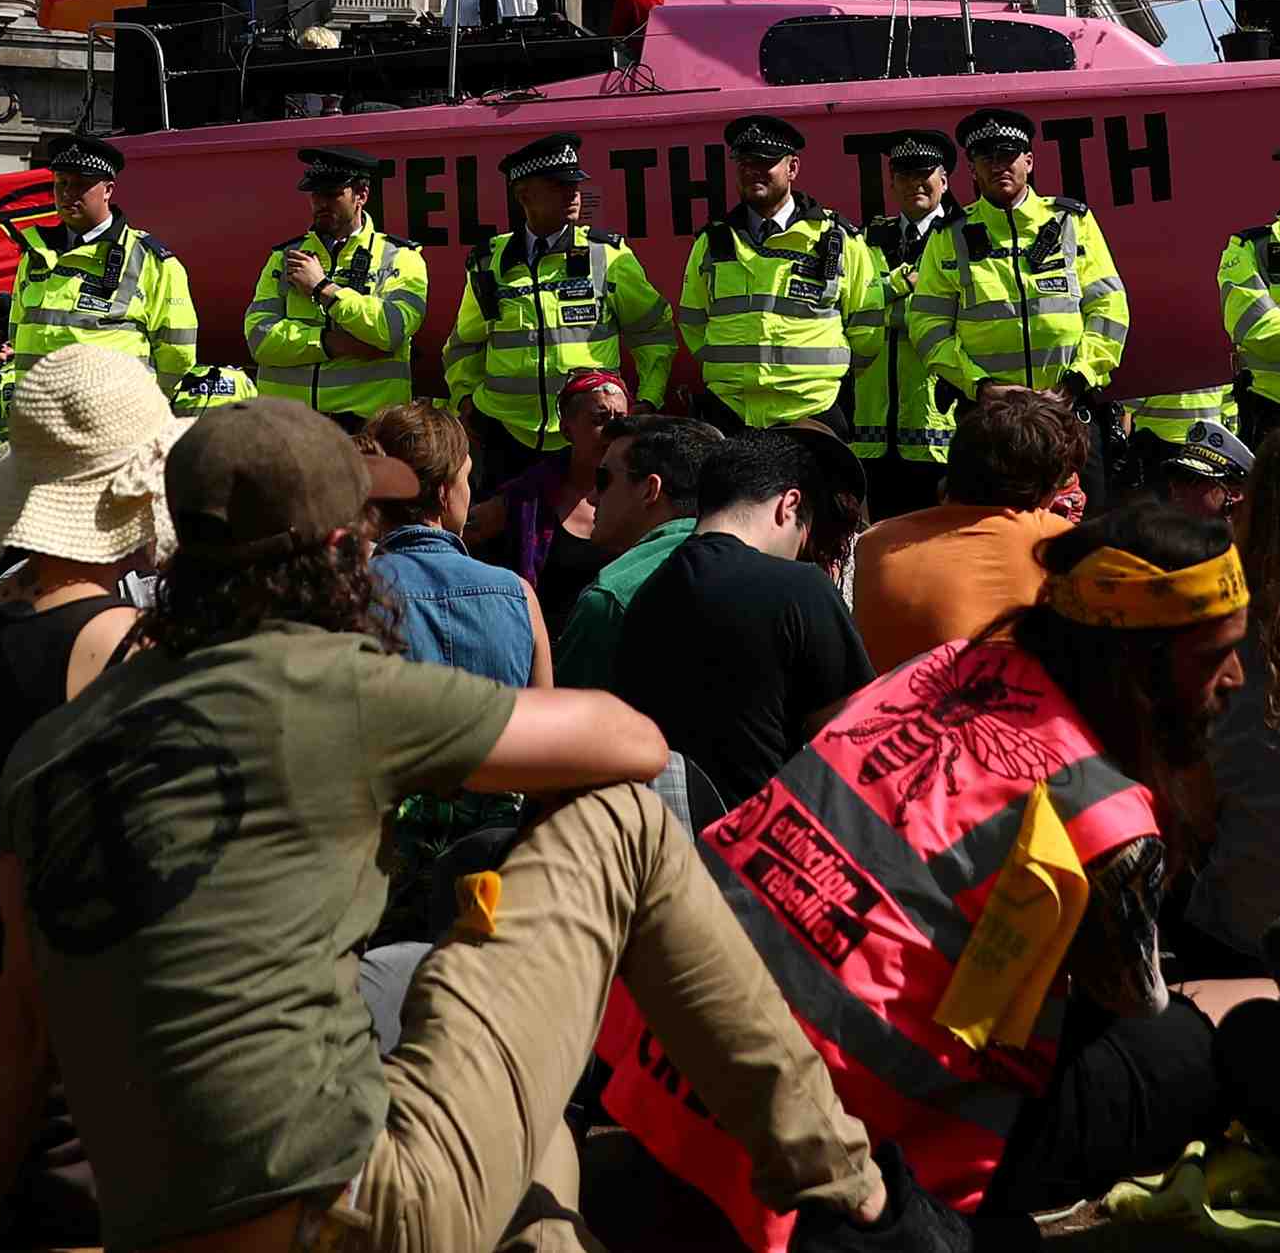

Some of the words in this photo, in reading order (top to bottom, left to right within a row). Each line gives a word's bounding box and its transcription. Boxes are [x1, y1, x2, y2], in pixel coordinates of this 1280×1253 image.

[842, 111, 1173, 222] TTH
[770, 816, 857, 902] extinction
[761, 863, 850, 958] rebellion
